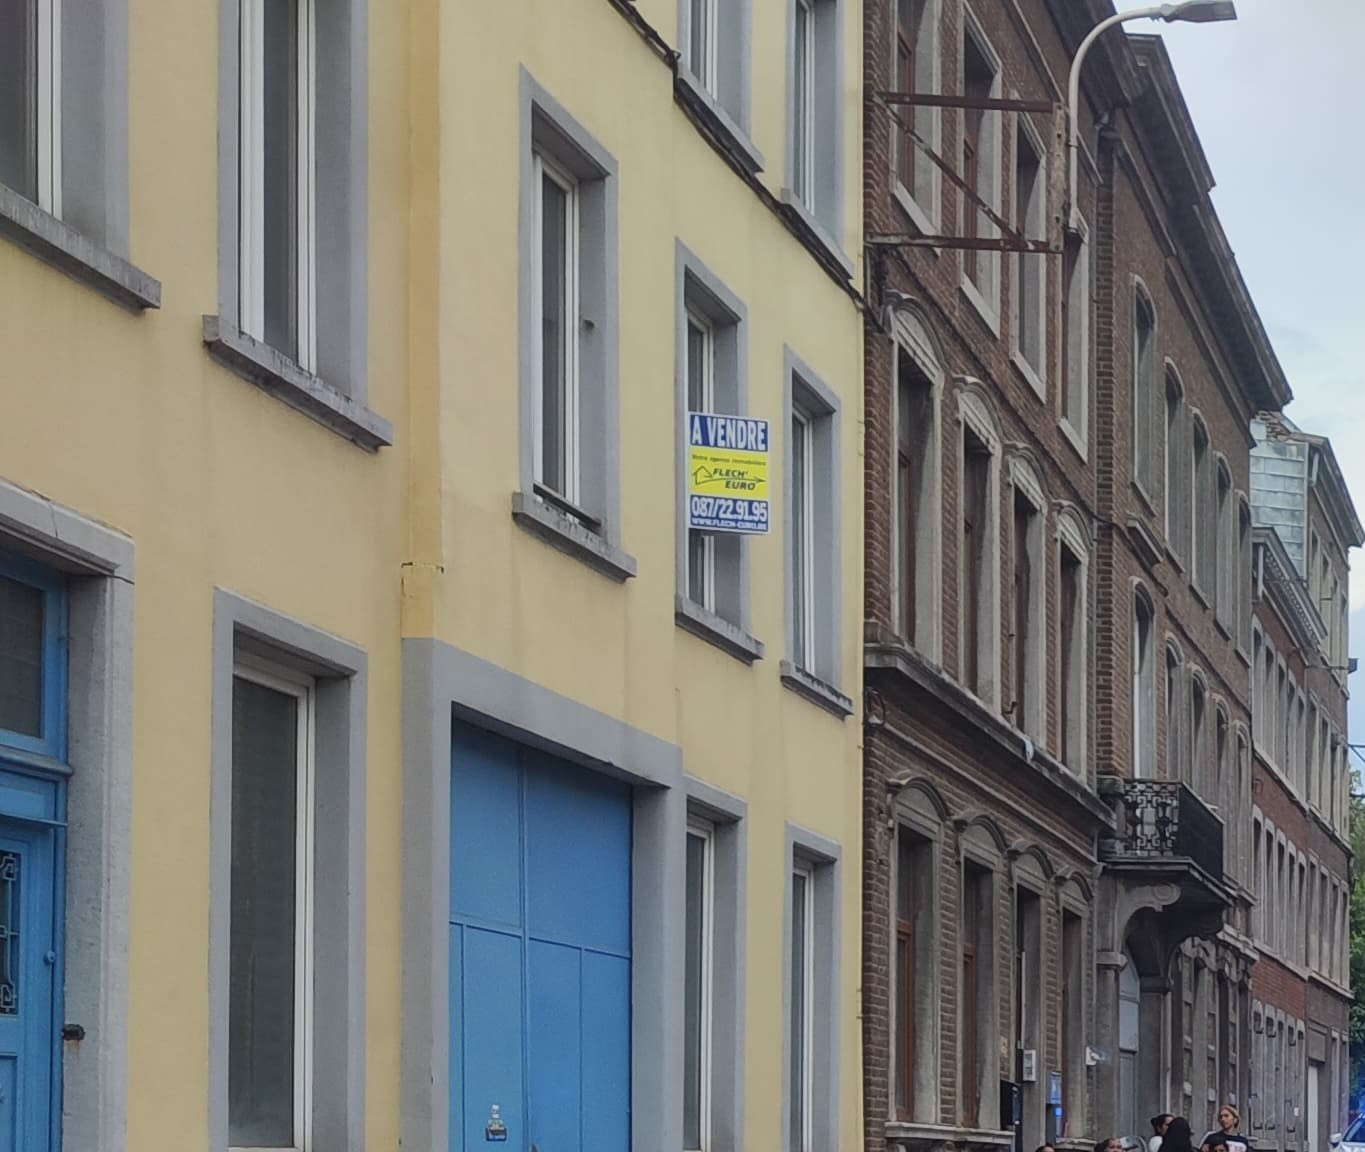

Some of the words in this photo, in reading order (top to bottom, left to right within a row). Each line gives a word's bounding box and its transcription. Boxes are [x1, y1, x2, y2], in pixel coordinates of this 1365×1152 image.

[692, 415, 703, 444] A
[707, 417, 766, 450] VENDRE
[725, 481, 756, 490] EURO
[691, 497, 767, 522] 087/22.91.95
